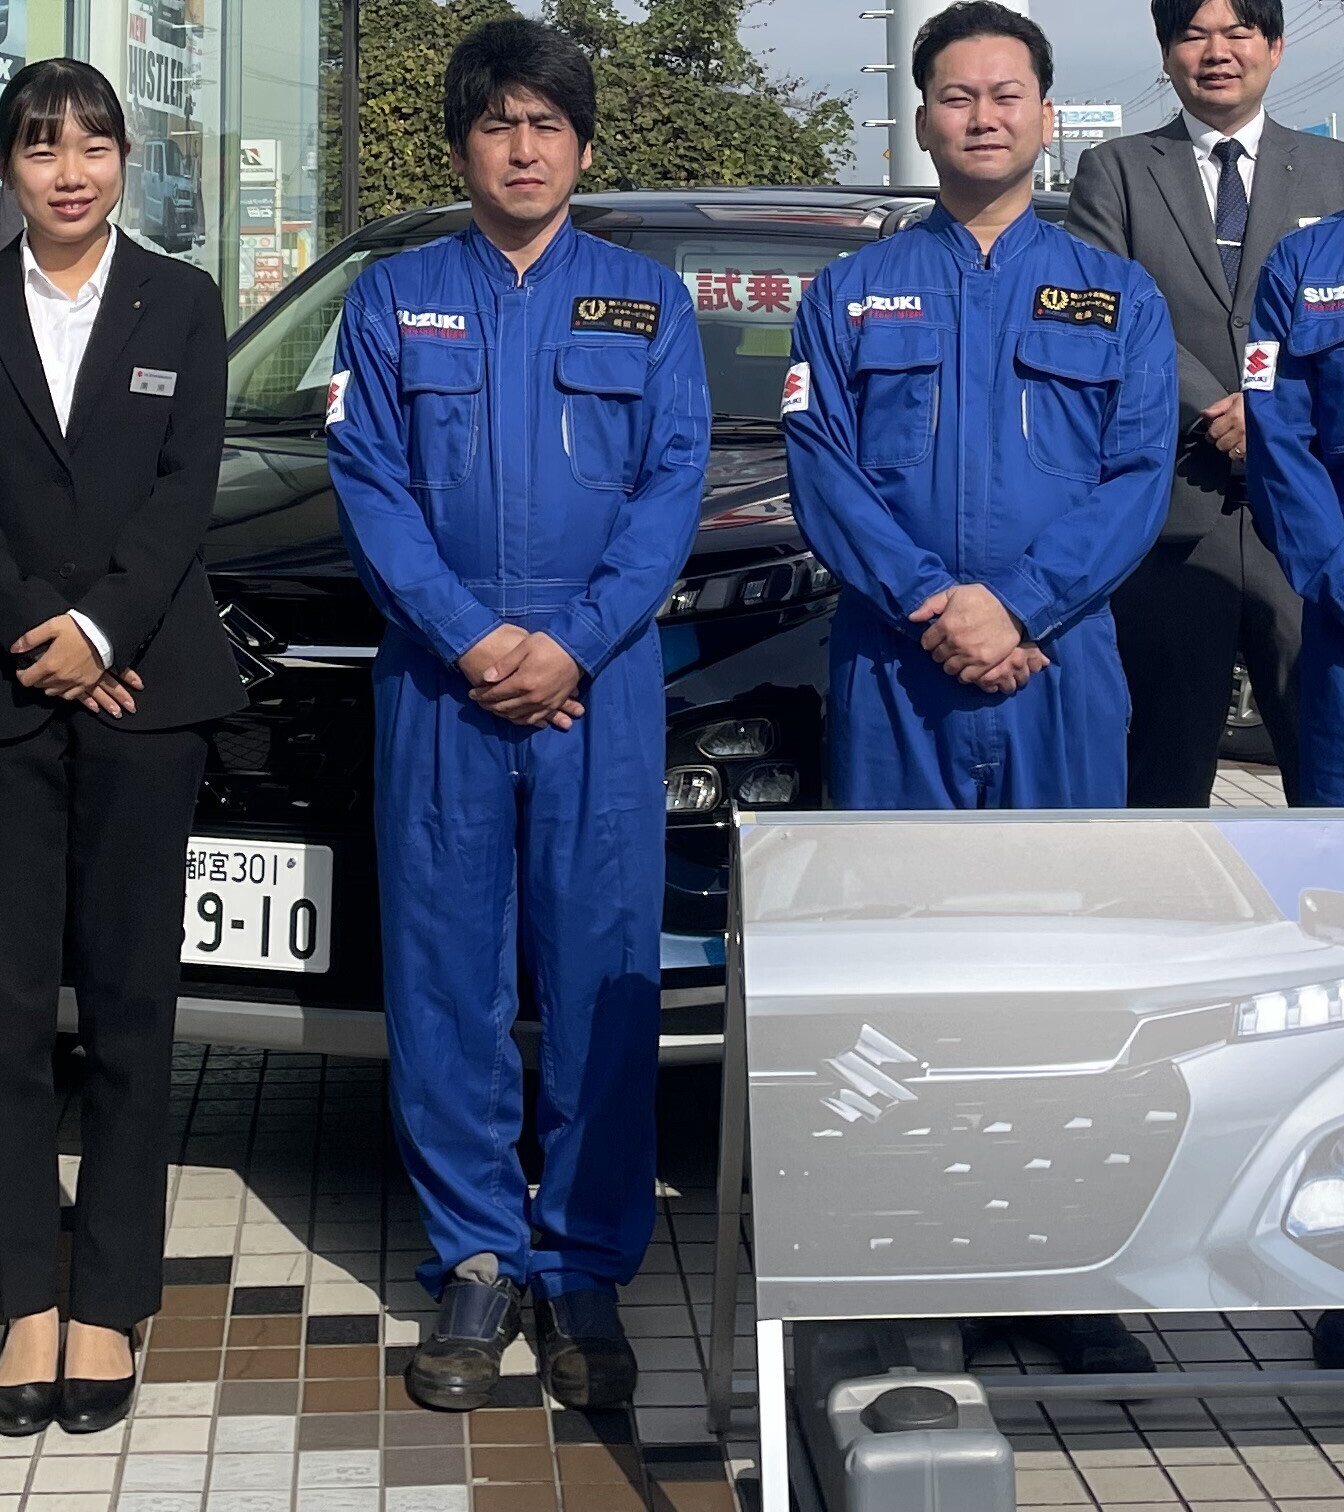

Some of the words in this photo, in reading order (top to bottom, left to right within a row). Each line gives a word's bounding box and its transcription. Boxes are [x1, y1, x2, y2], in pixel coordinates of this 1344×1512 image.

[128, 44, 184, 109] HUSTLER
[847, 295, 922, 317] SUZUKI
[185, 849, 278, 886] 都宮301
[196, 891, 318, 960] 9-10
